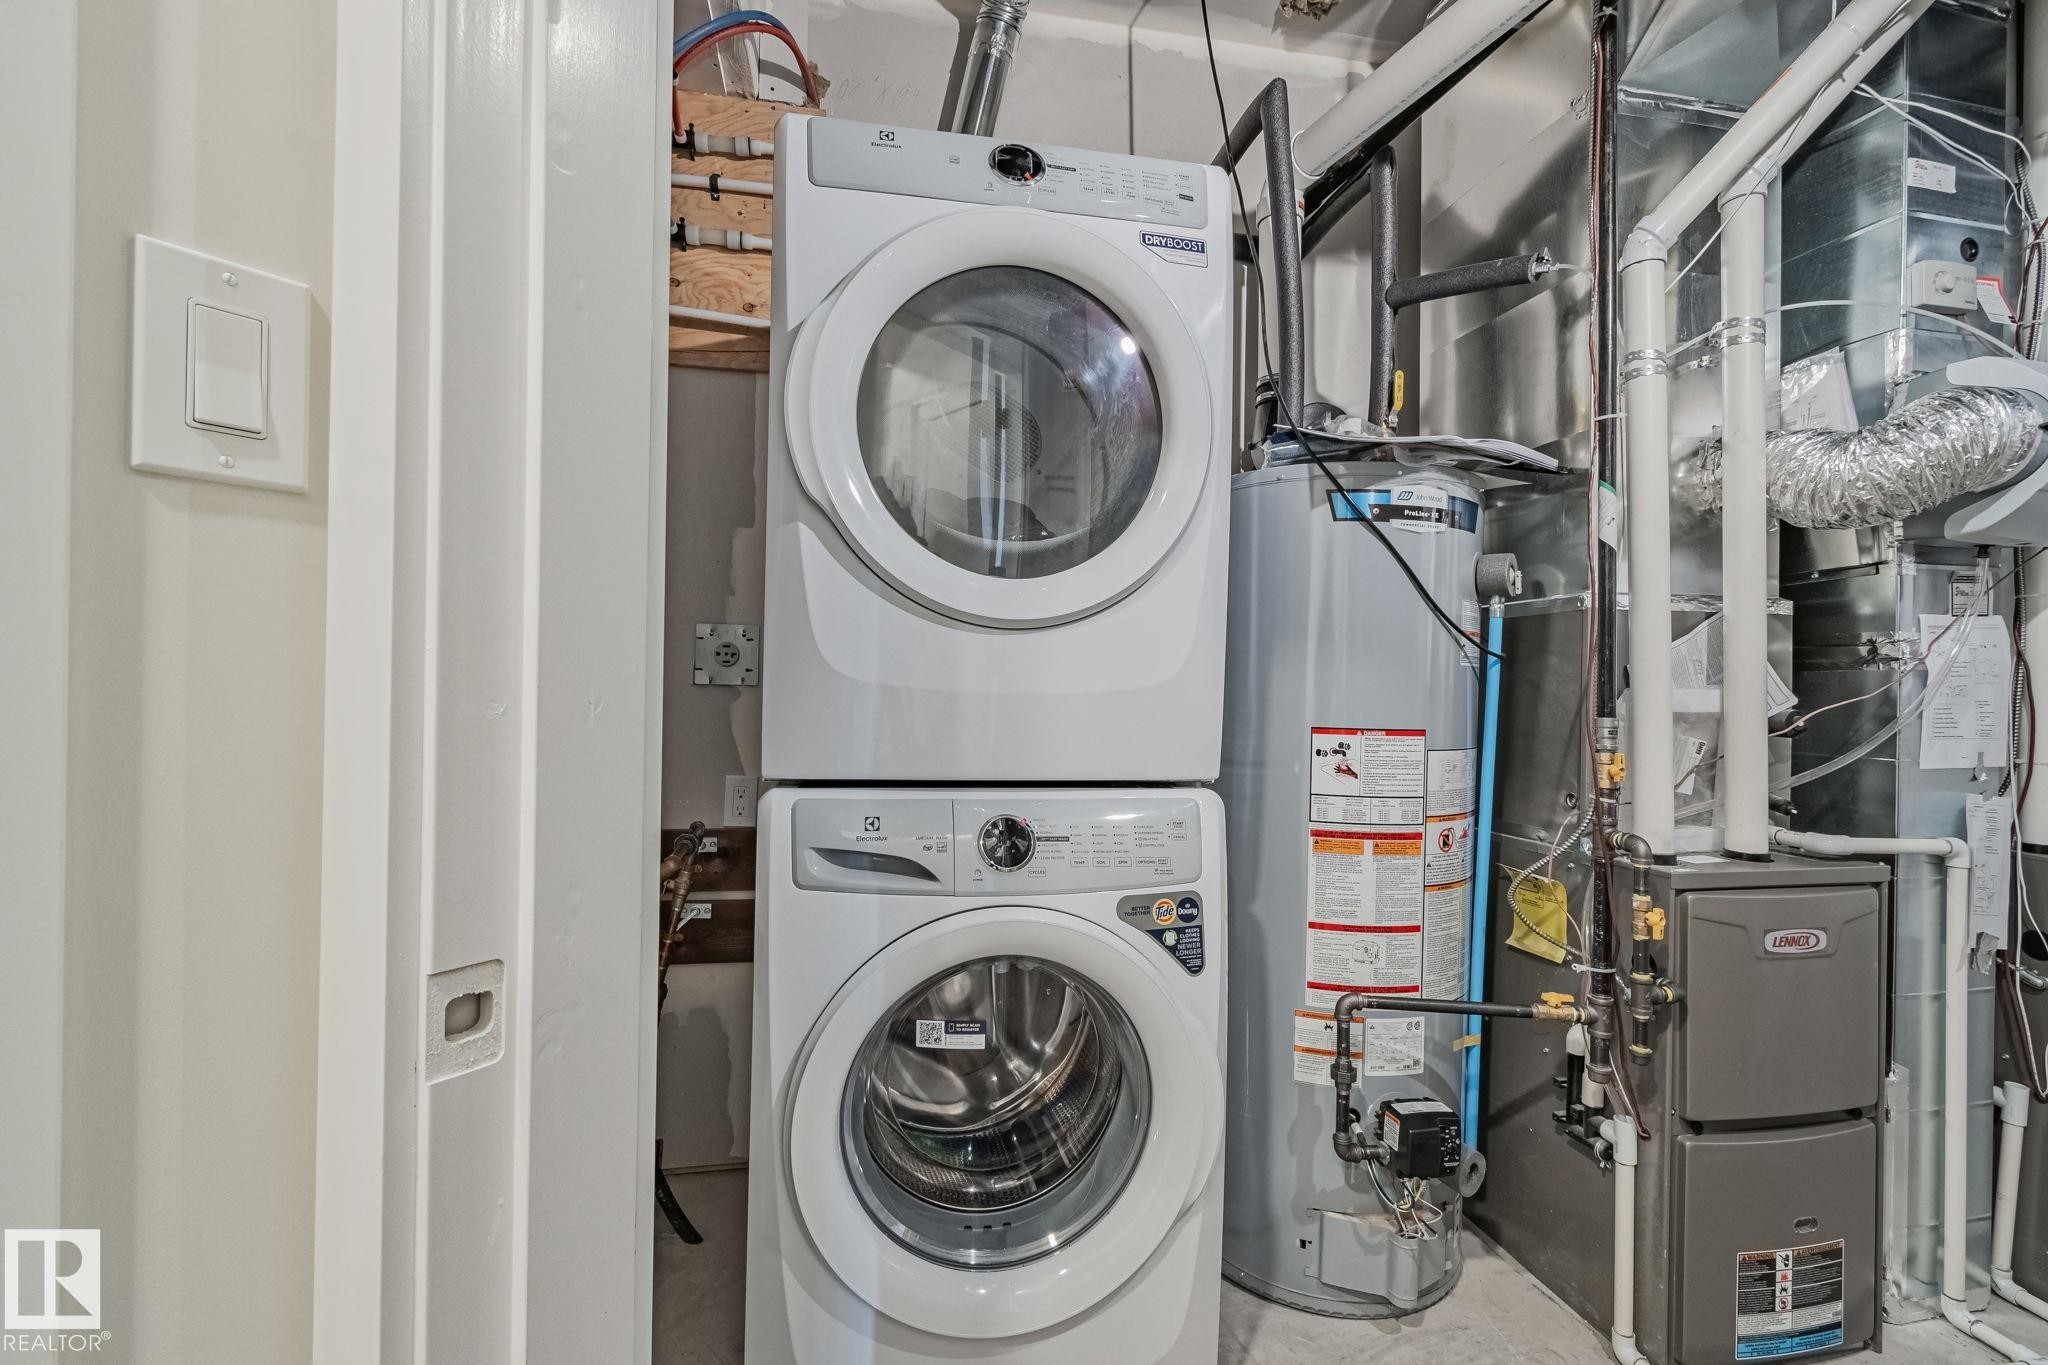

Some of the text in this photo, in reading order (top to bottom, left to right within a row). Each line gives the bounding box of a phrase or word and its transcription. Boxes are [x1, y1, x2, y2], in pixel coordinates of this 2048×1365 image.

[871, 141, 903, 149] Electrolux
[1145, 234, 1203, 252] DRYBOOST
[1156, 905, 1174, 920] Tide
[1178, 907, 1198, 915] Downy
[1772, 935, 1812, 948] LENNOX
